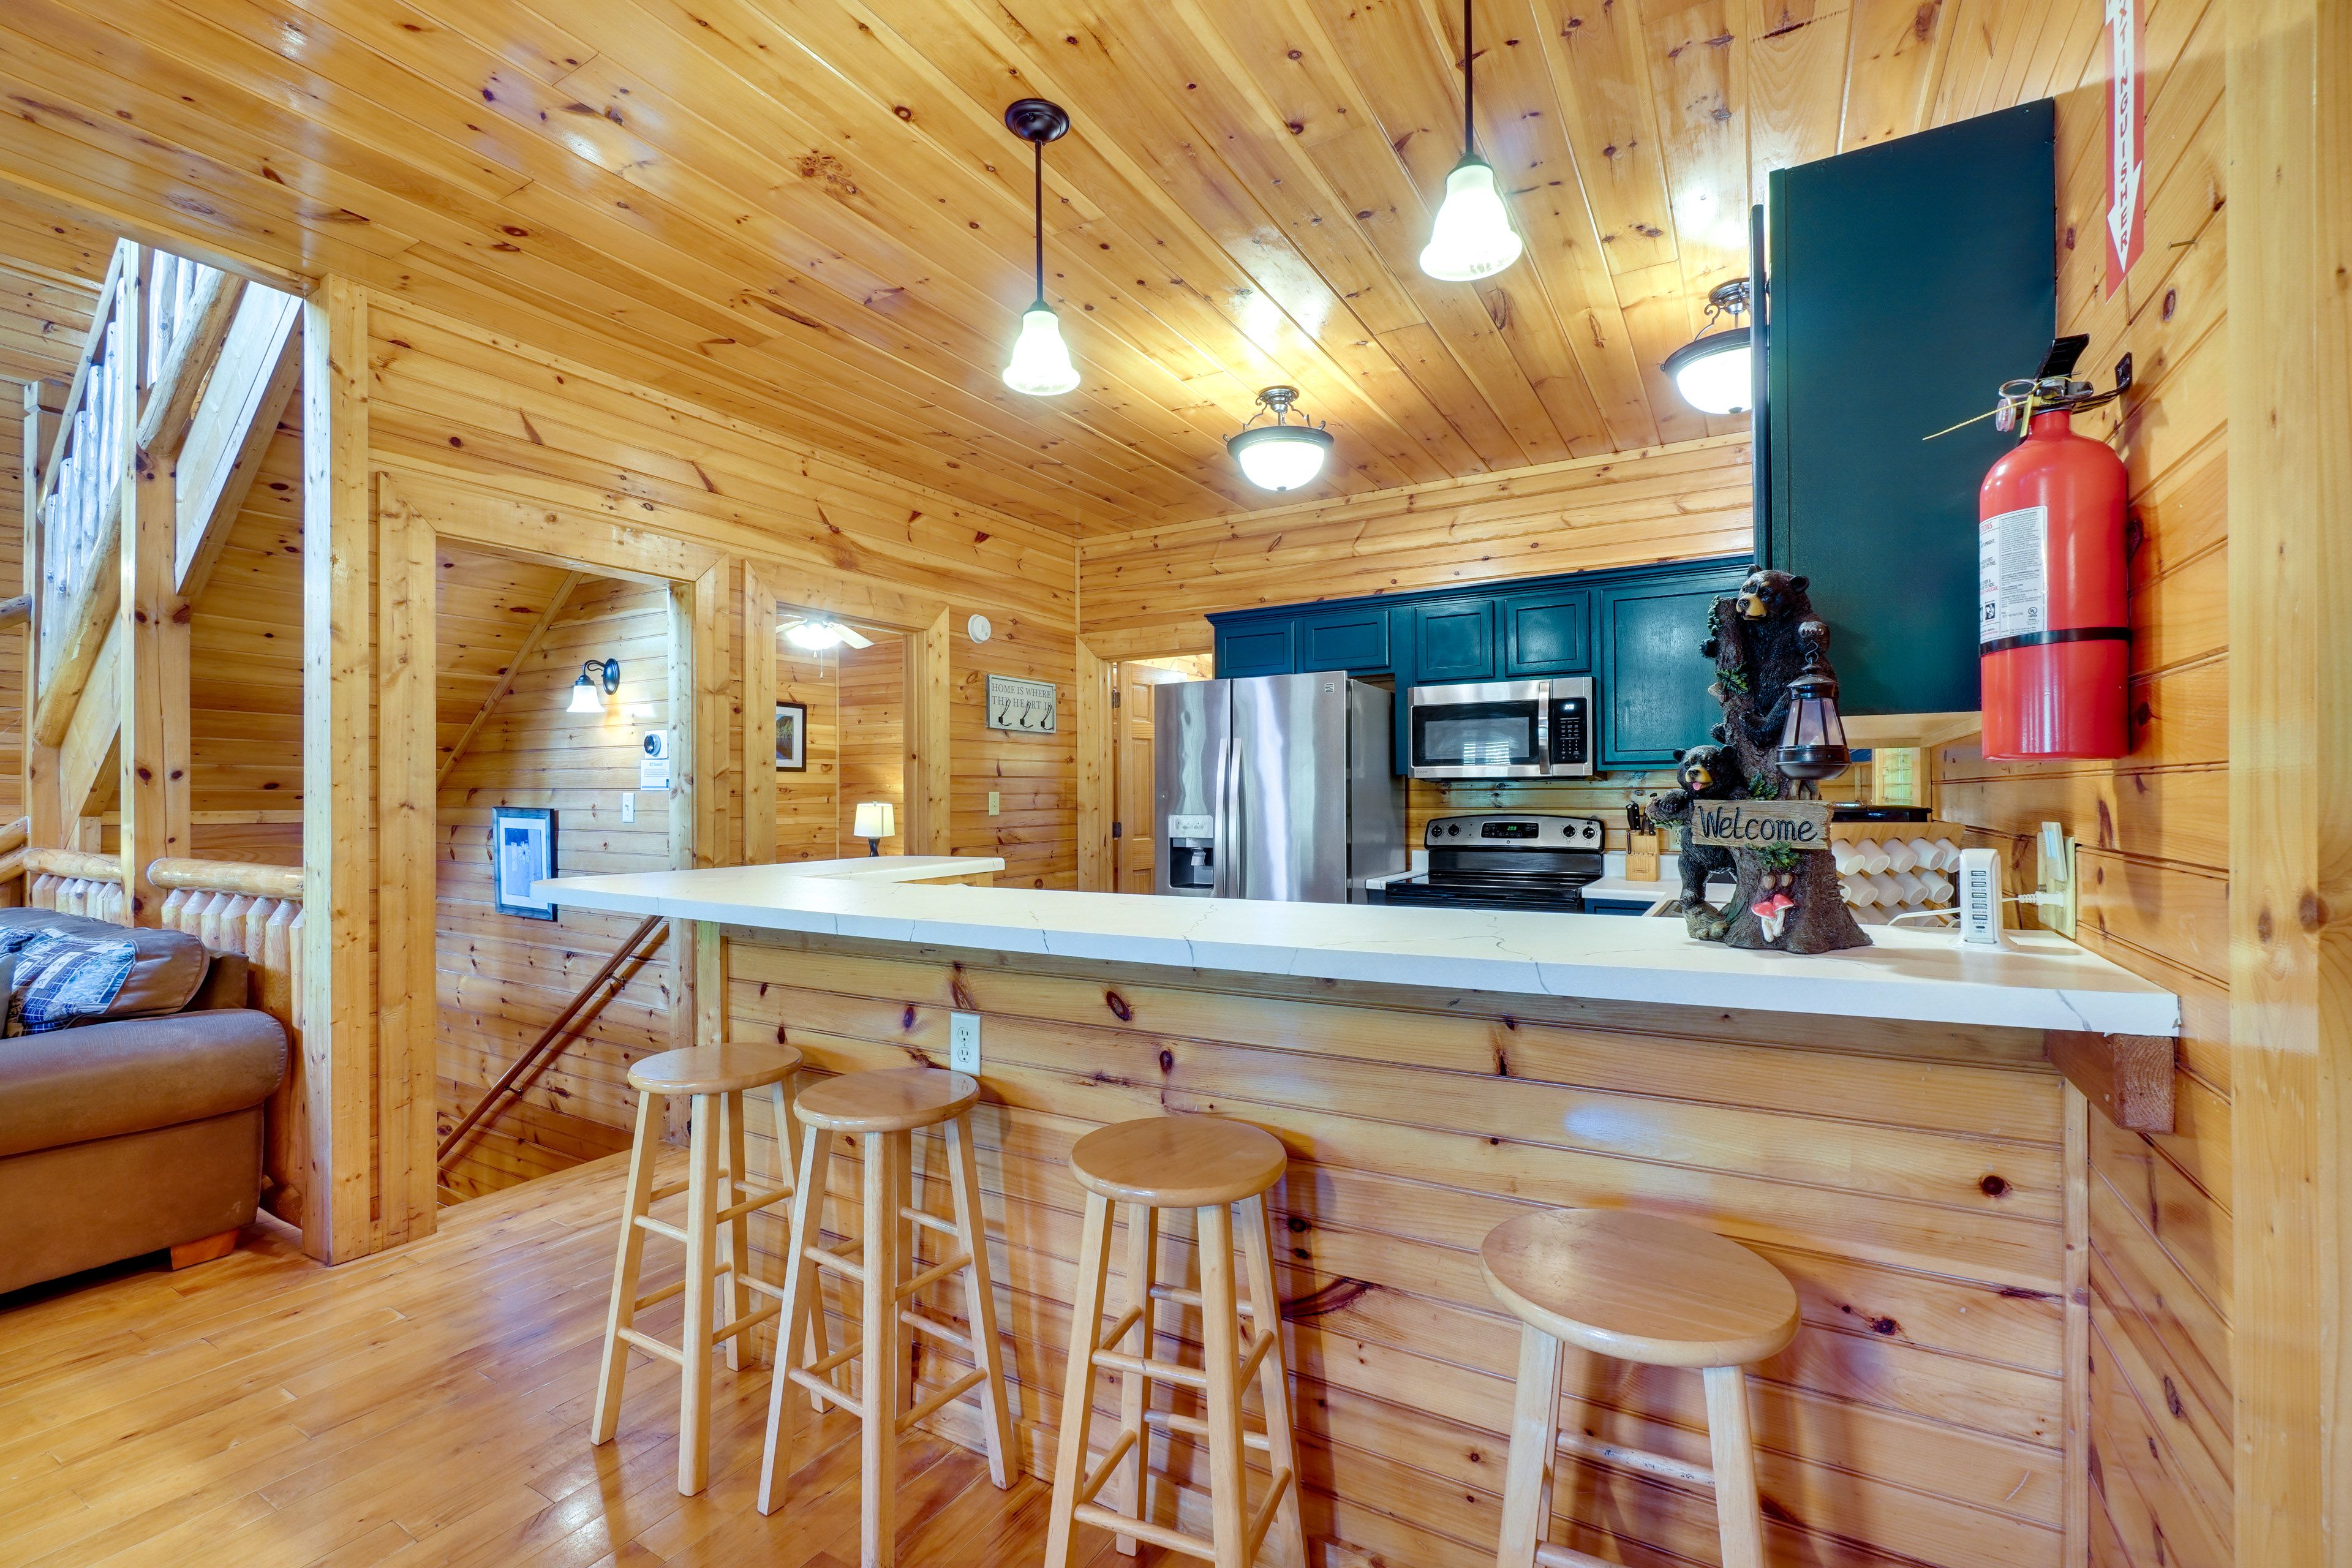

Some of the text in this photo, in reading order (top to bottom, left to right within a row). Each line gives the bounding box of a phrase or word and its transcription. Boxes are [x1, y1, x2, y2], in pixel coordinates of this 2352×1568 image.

[992, 683, 1052, 698] HOME IS WHERE
[1697, 805, 1818, 842] Welcome
